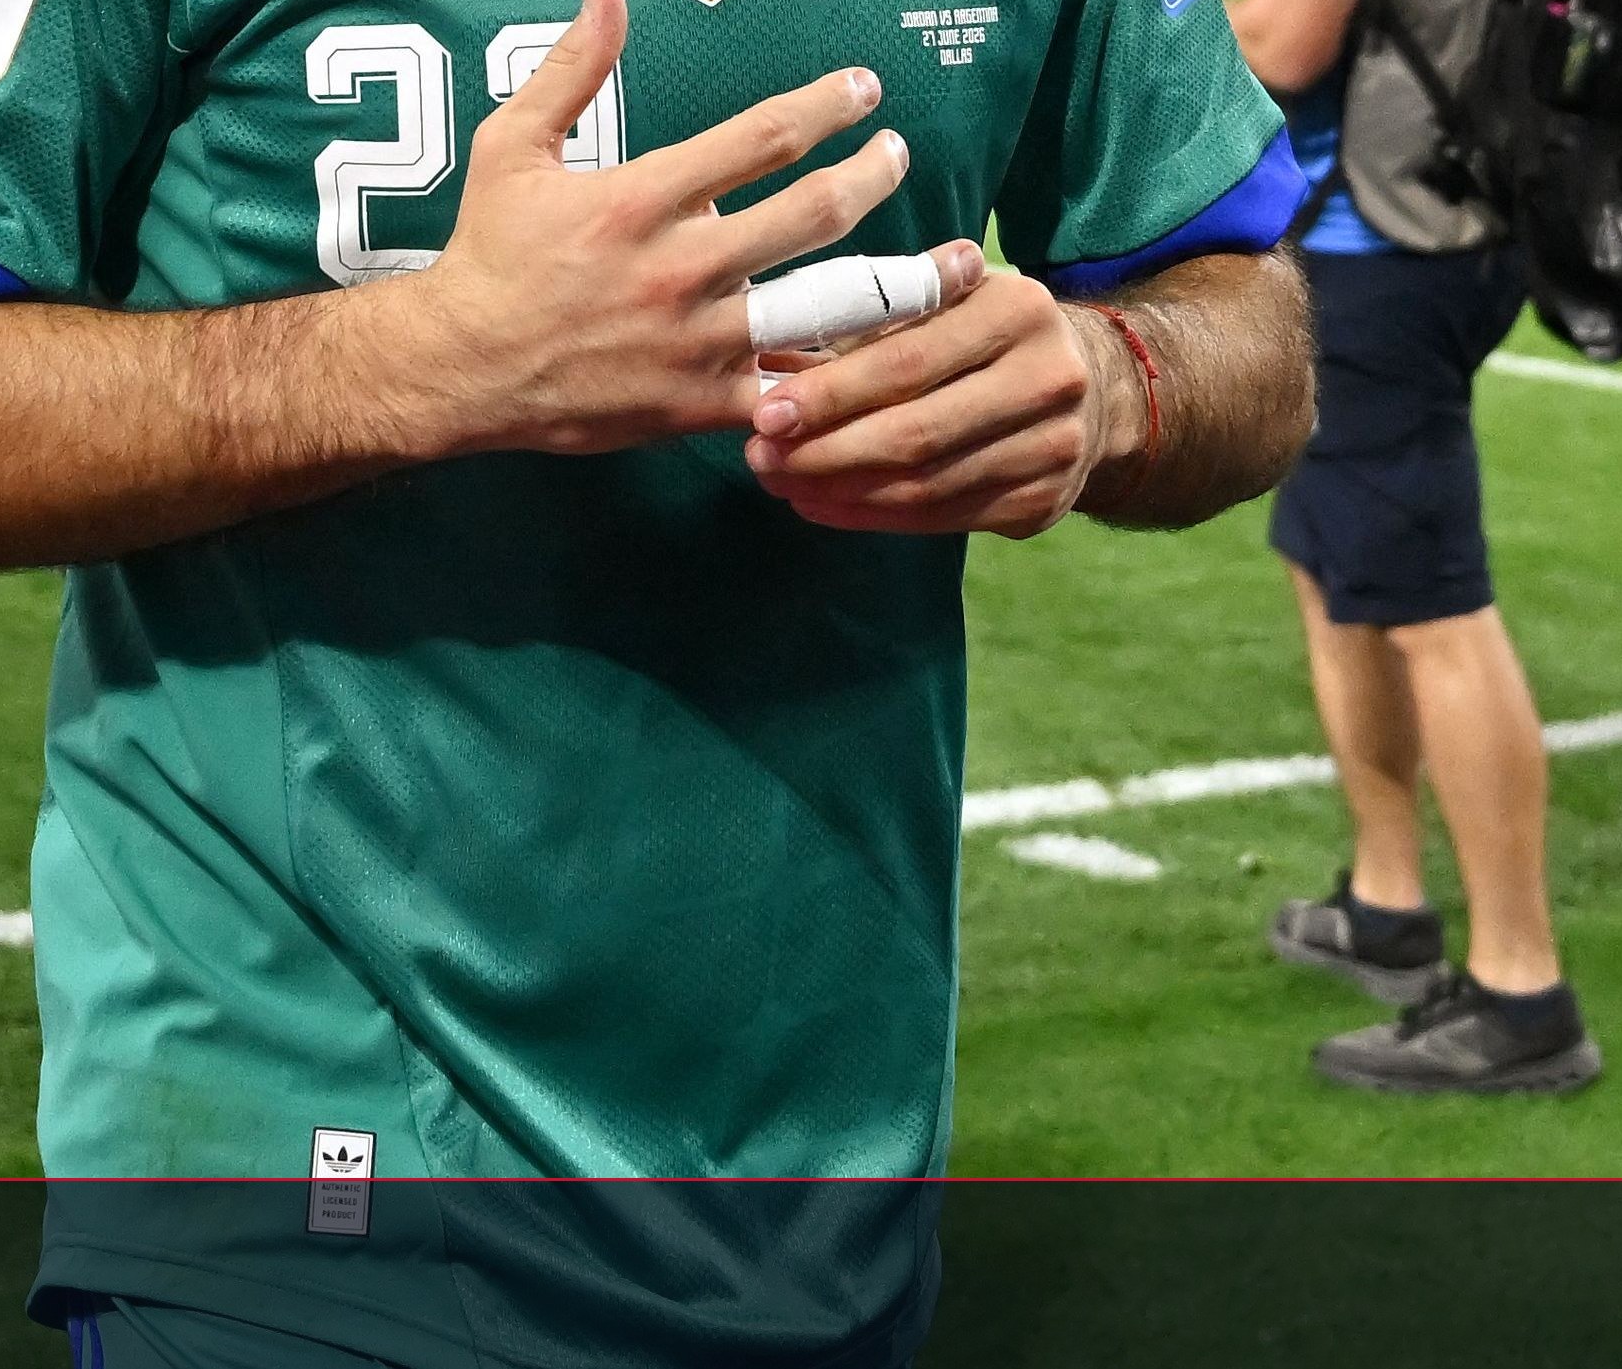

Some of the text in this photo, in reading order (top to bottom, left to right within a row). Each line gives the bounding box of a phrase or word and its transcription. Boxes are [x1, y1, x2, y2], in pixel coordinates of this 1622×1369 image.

[900, 6, 999, 28] JORDAN VS ARGENTINA
[921, 26, 986, 47] 27 JUNE 2026
[939, 47, 973, 66] DALLAS
